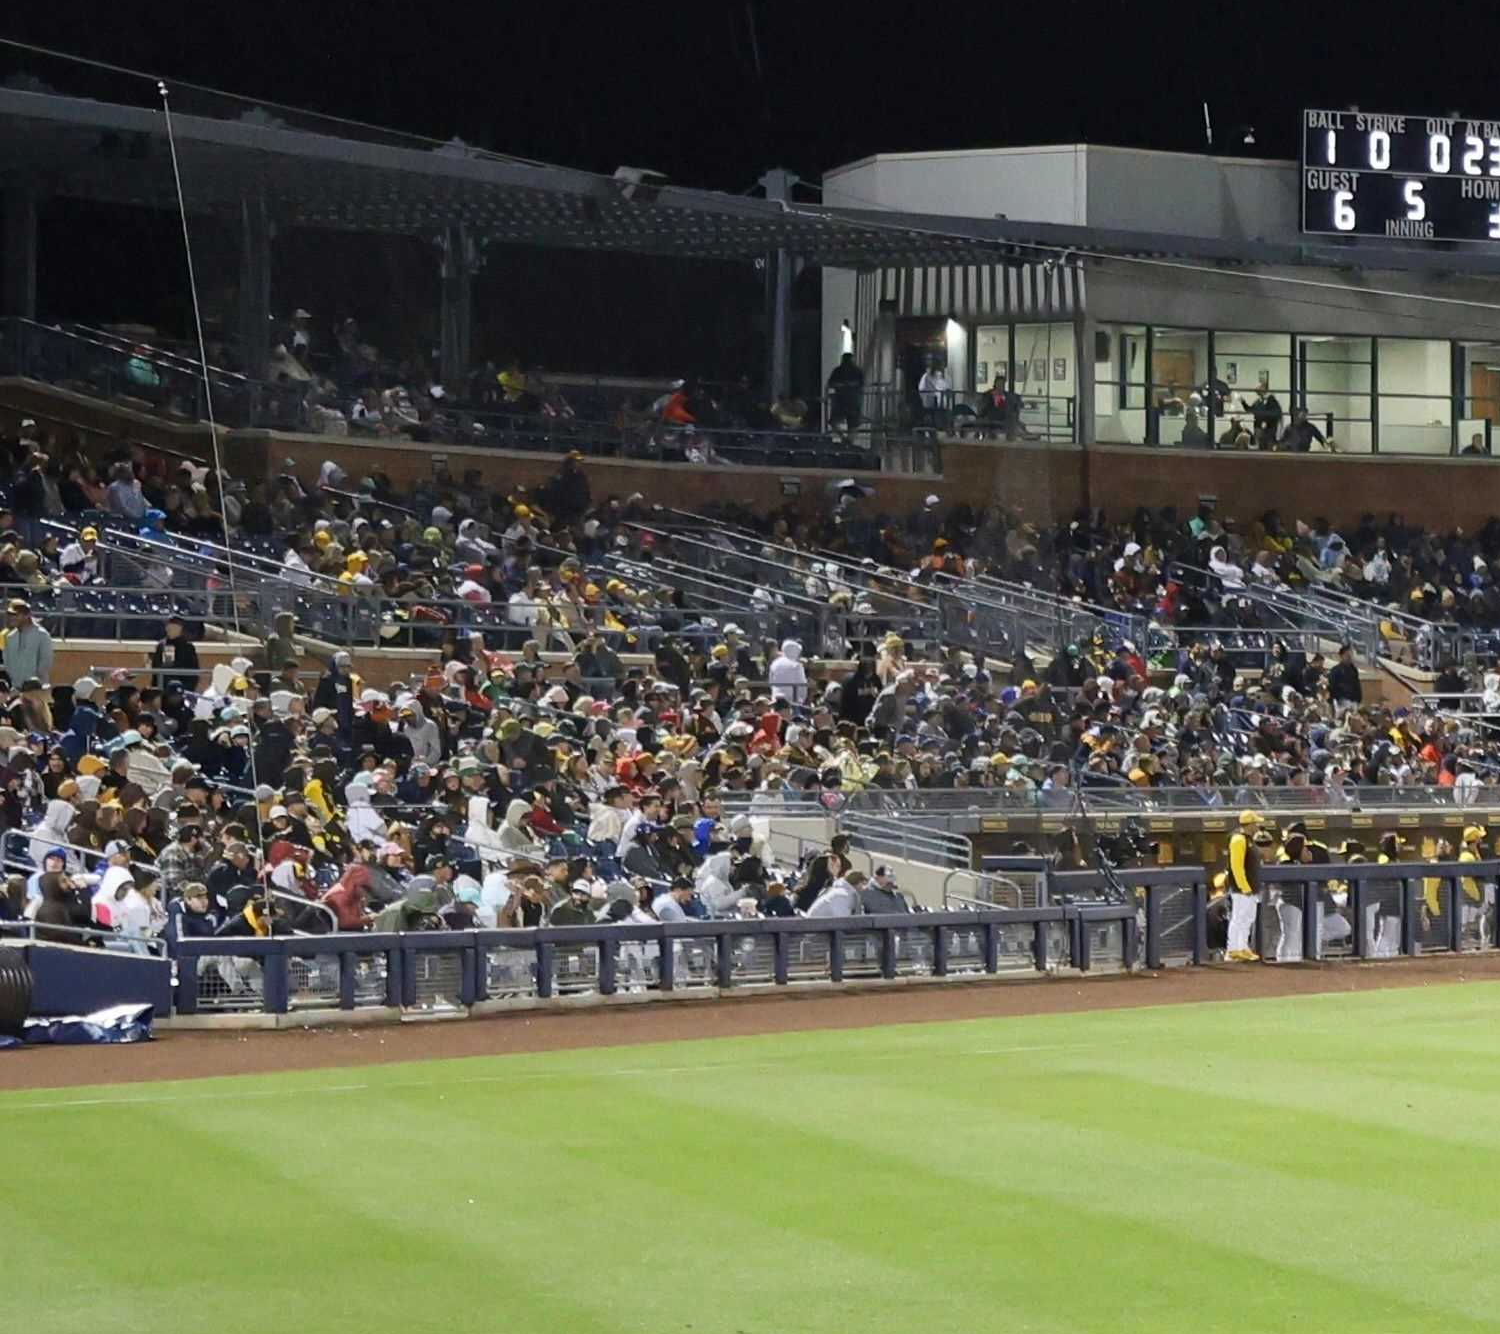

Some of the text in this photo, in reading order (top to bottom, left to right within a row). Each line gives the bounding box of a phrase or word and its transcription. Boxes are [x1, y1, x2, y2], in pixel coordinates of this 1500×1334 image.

[1308, 112, 1345, 130] BALL
[1356, 116, 1406, 134] STRIKE
[1426, 118, 1454, 136] OUT
[1466, 123, 1481, 137] AT
[1327, 130, 1336, 164] 1
[1369, 130, 1390, 170] 0
[1430, 134, 1450, 173] 0
[1307, 170, 1360, 191] GUEST
[1334, 191, 1356, 231] 6
[1404, 181, 1425, 220] 5
[1385, 220, 1434, 238] INNING
